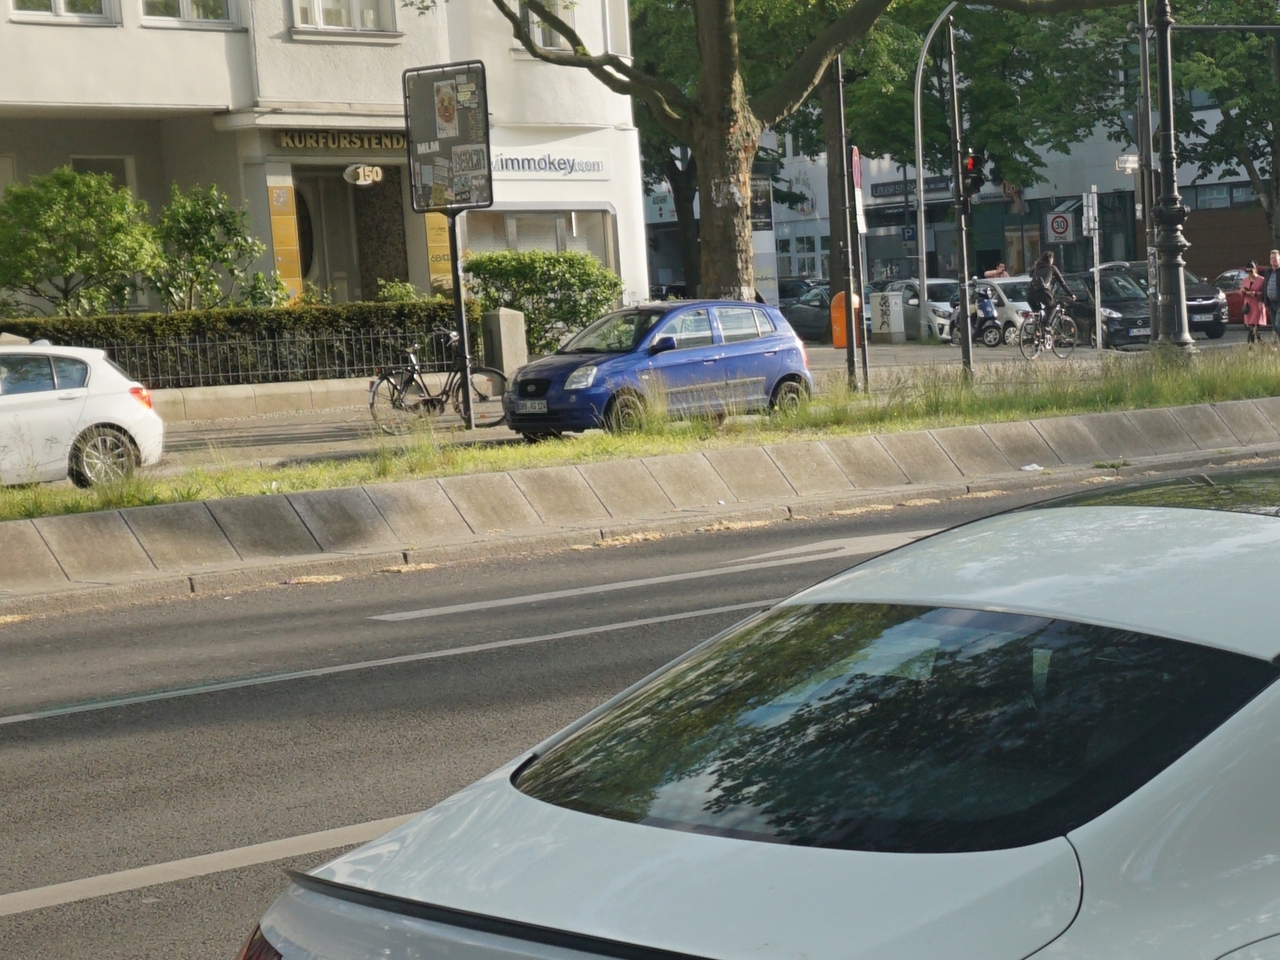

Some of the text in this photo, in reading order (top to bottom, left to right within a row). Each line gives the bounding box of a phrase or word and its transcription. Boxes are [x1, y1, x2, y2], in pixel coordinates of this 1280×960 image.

[355, 166, 383, 182] 150
[1054, 220, 1066, 229] 30
[904, 229, 913, 239] P
